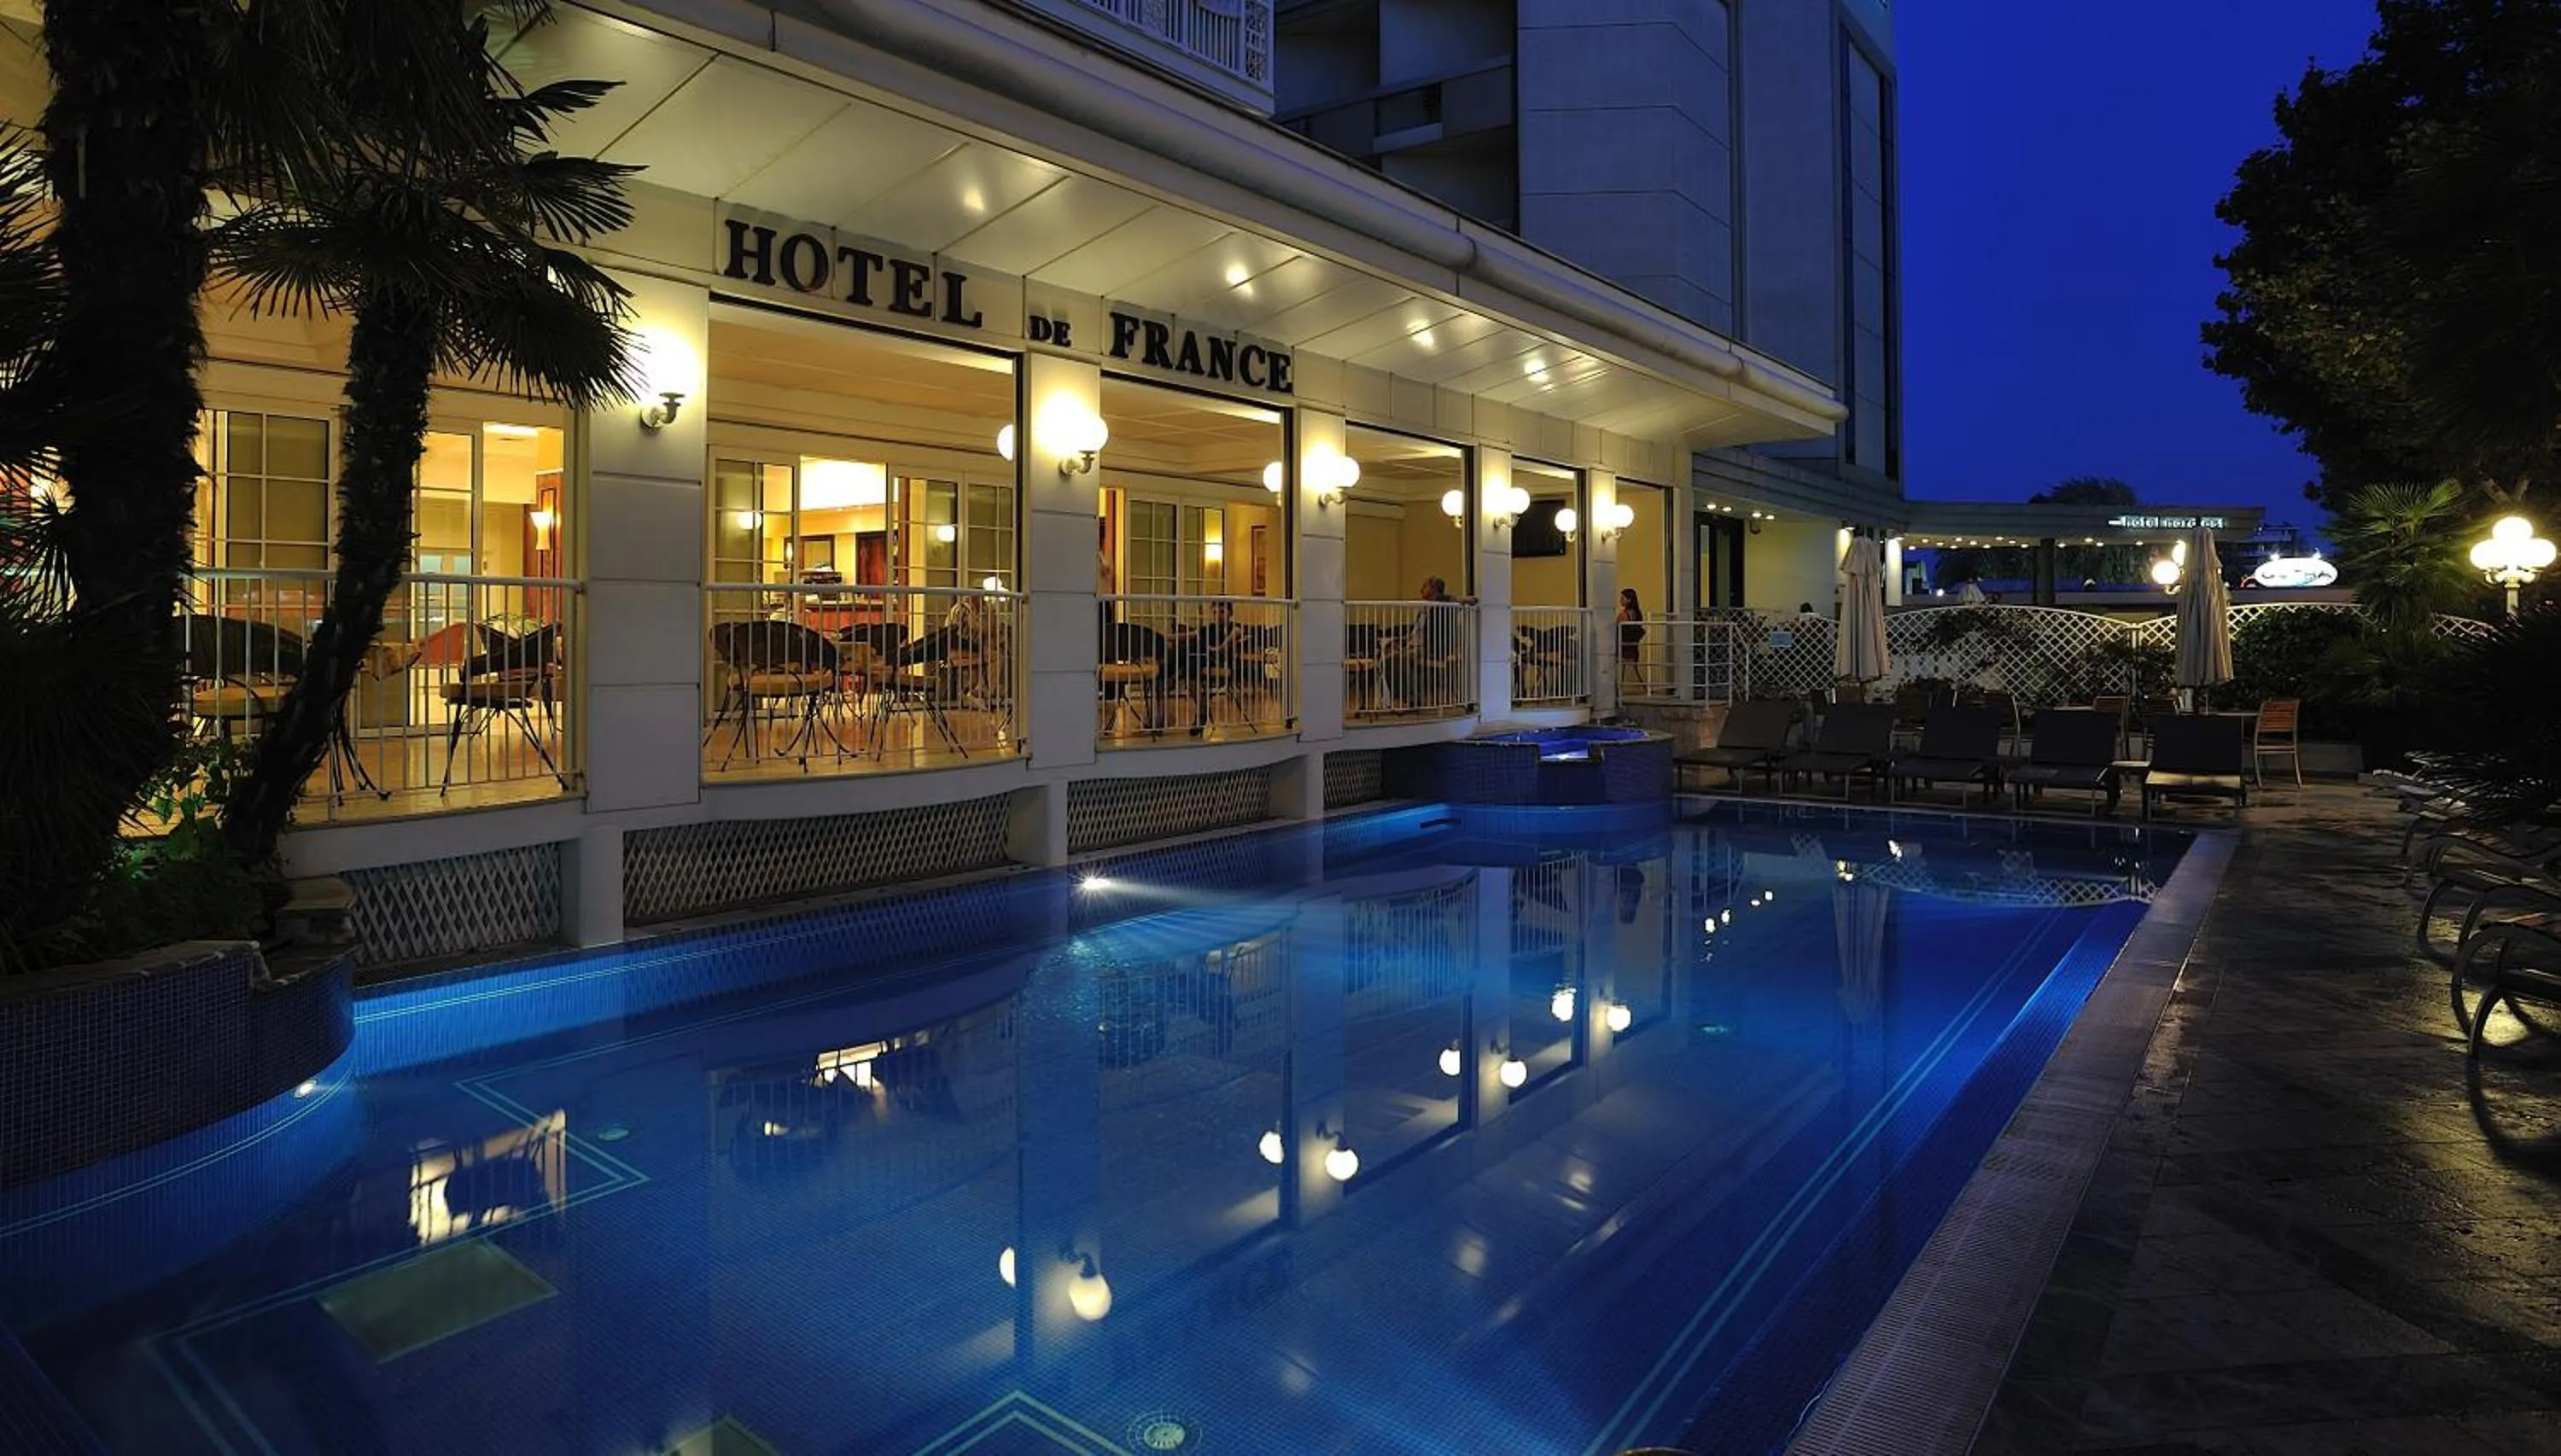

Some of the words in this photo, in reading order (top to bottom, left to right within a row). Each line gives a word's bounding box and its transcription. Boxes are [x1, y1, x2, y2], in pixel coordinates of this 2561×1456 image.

[724, 218, 983, 329] HOTEL
[1030, 315, 1071, 347] DE
[1111, 311, 1294, 393] FRANCE
